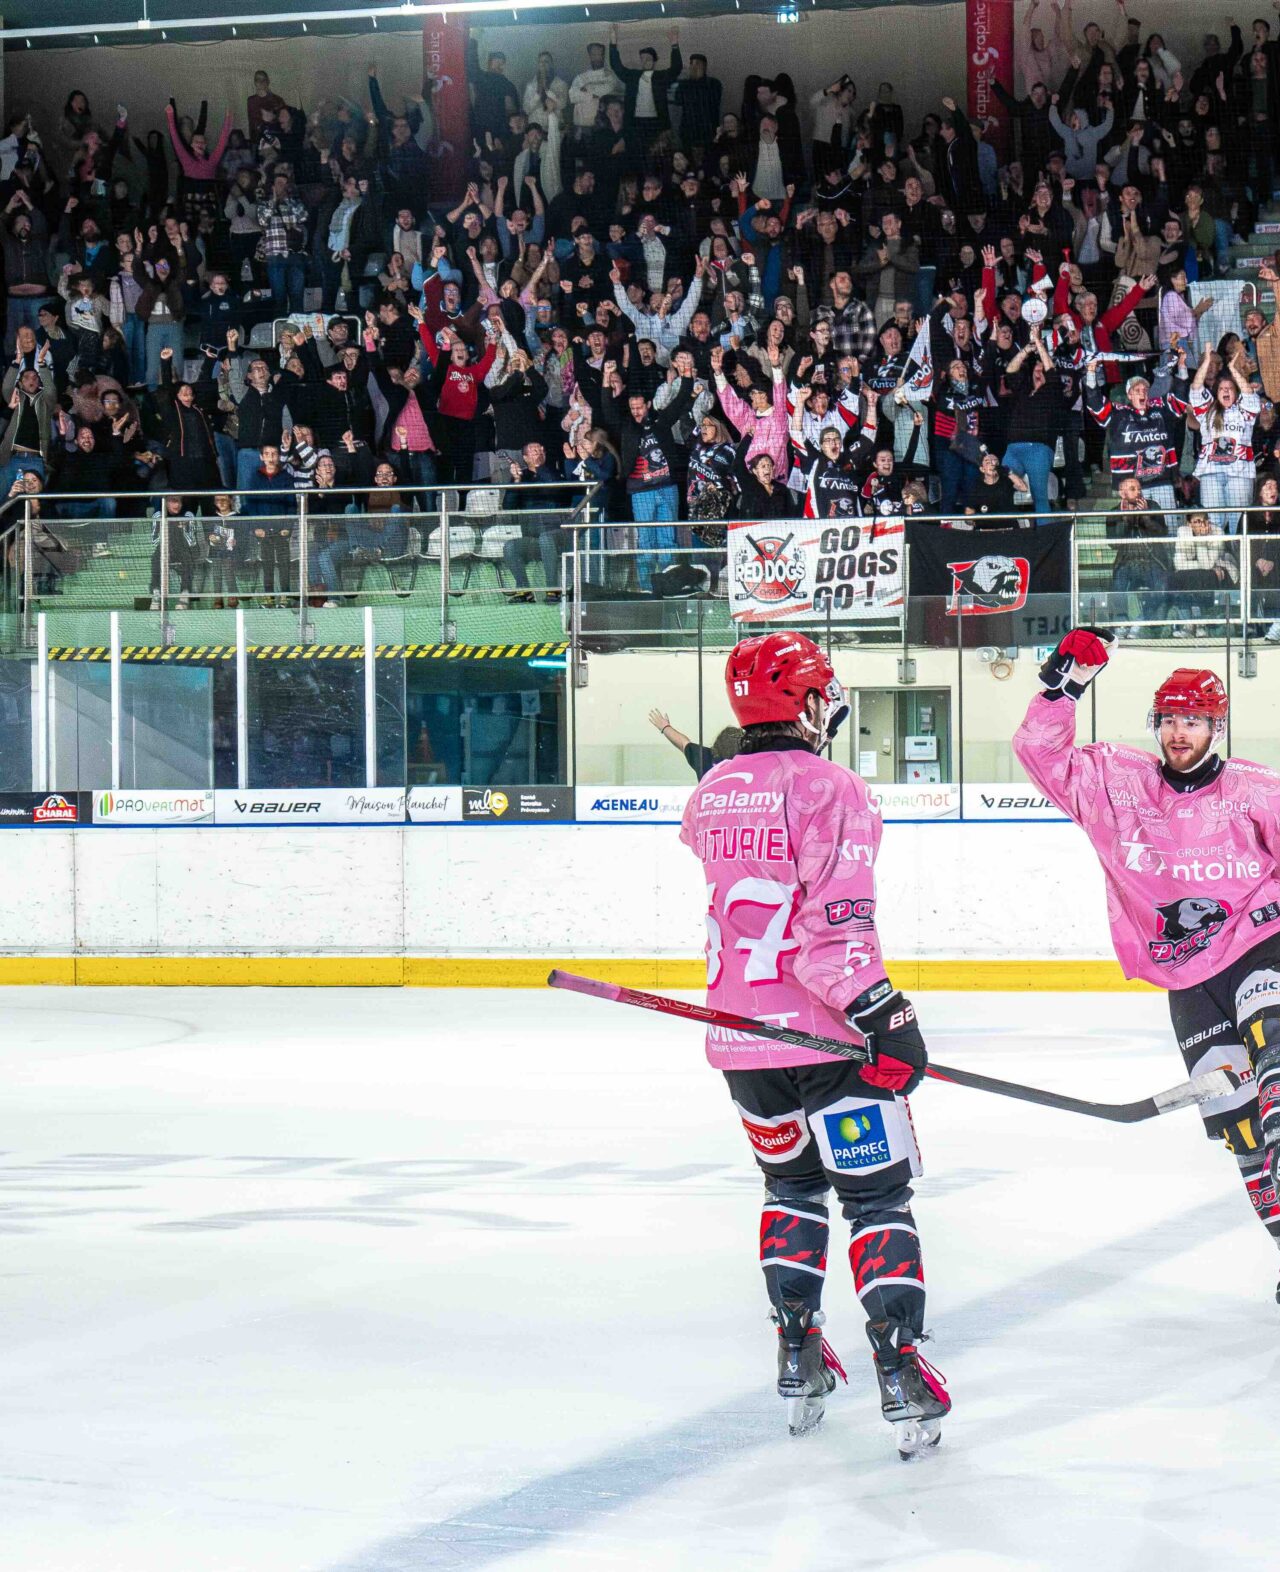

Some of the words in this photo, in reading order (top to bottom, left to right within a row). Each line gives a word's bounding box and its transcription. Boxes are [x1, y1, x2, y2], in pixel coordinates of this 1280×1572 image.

[819, 525, 862, 554] GO
[764, 560, 807, 584] DOGS
[815, 549, 899, 584] DOGS
[812, 583, 855, 612] GO
[733, 680, 749, 697] 57
[249, 802, 322, 813] BAUER
[590, 799, 659, 811] AGENEAU
[700, 789, 785, 813] Palamy
[996, 797, 1056, 809] BAUE
[36, 808, 74, 819] CHARAL
[1185, 1019, 1232, 1049] BAUER
[833, 1140, 888, 1161] PAPREC
[837, 1154, 890, 1168] RECYCLAGE
